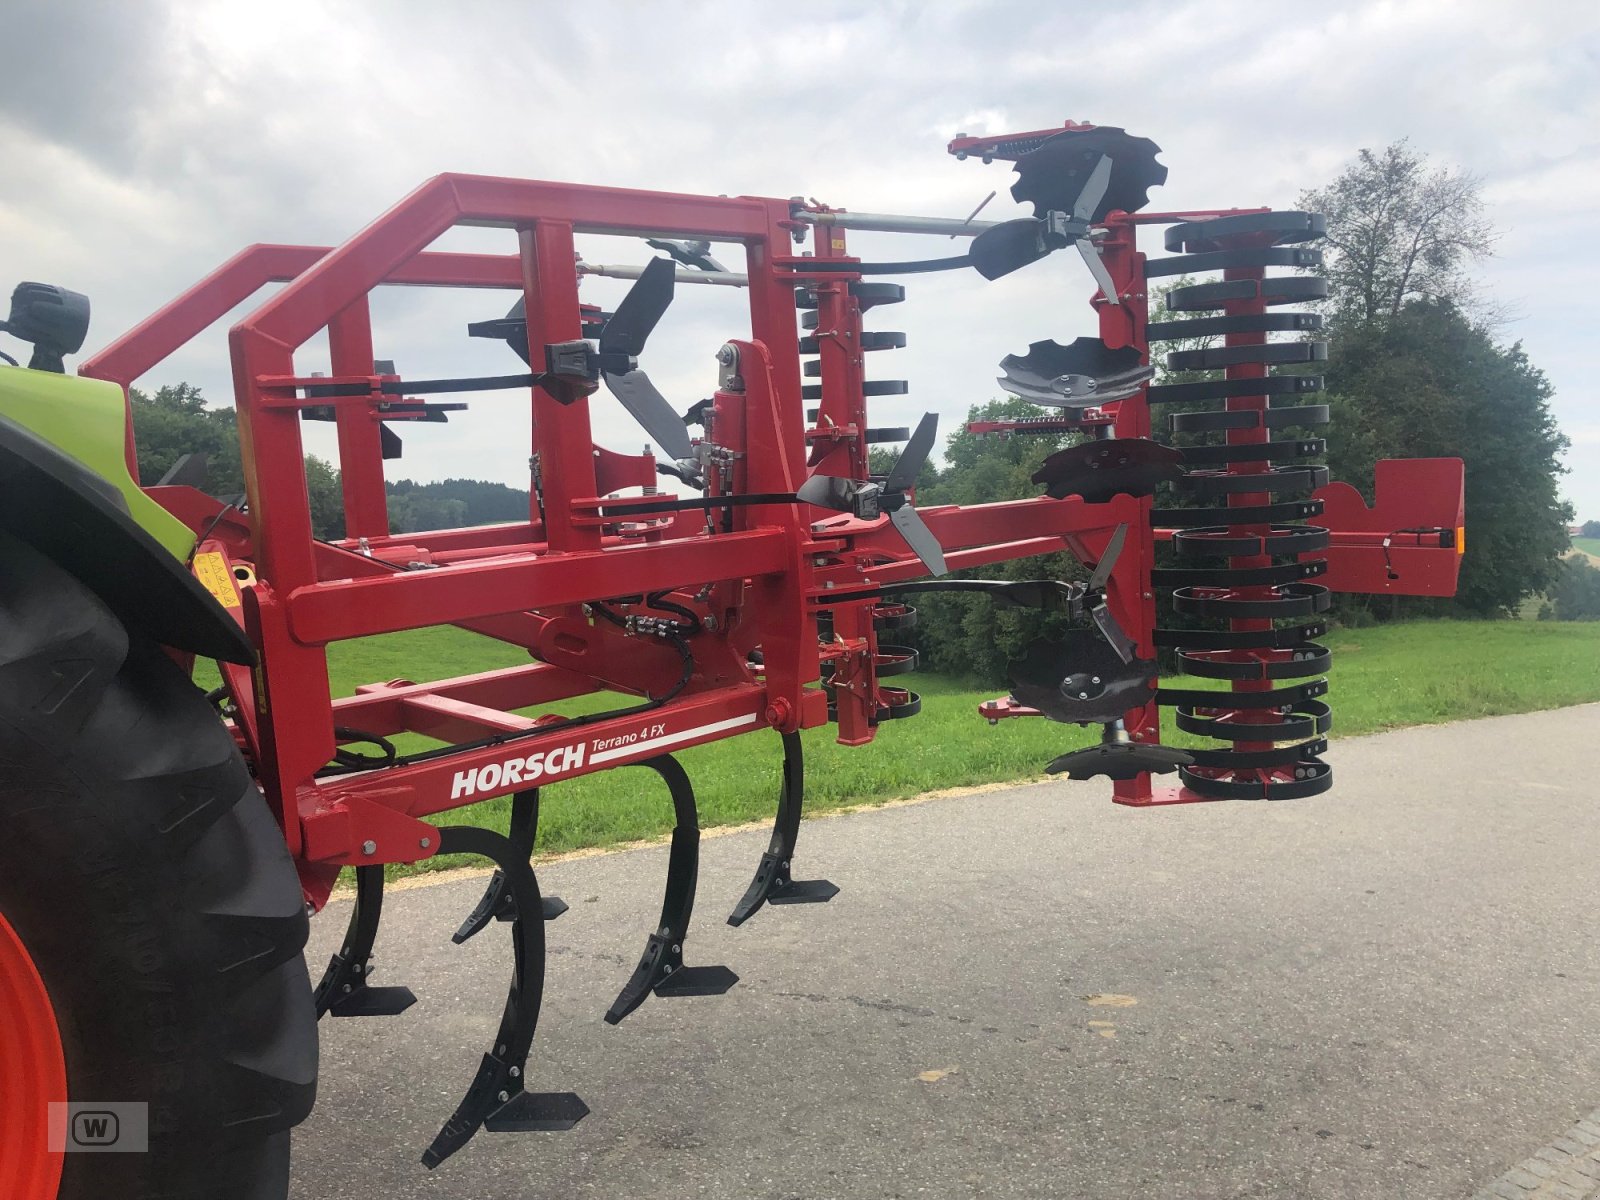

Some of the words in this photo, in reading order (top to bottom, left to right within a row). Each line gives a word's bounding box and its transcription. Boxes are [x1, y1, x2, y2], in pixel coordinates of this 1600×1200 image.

[592, 733, 637, 751] Terrano
[640, 727, 648, 739] 4
[650, 723, 666, 737] FX
[450, 742, 586, 799] HORSCH
